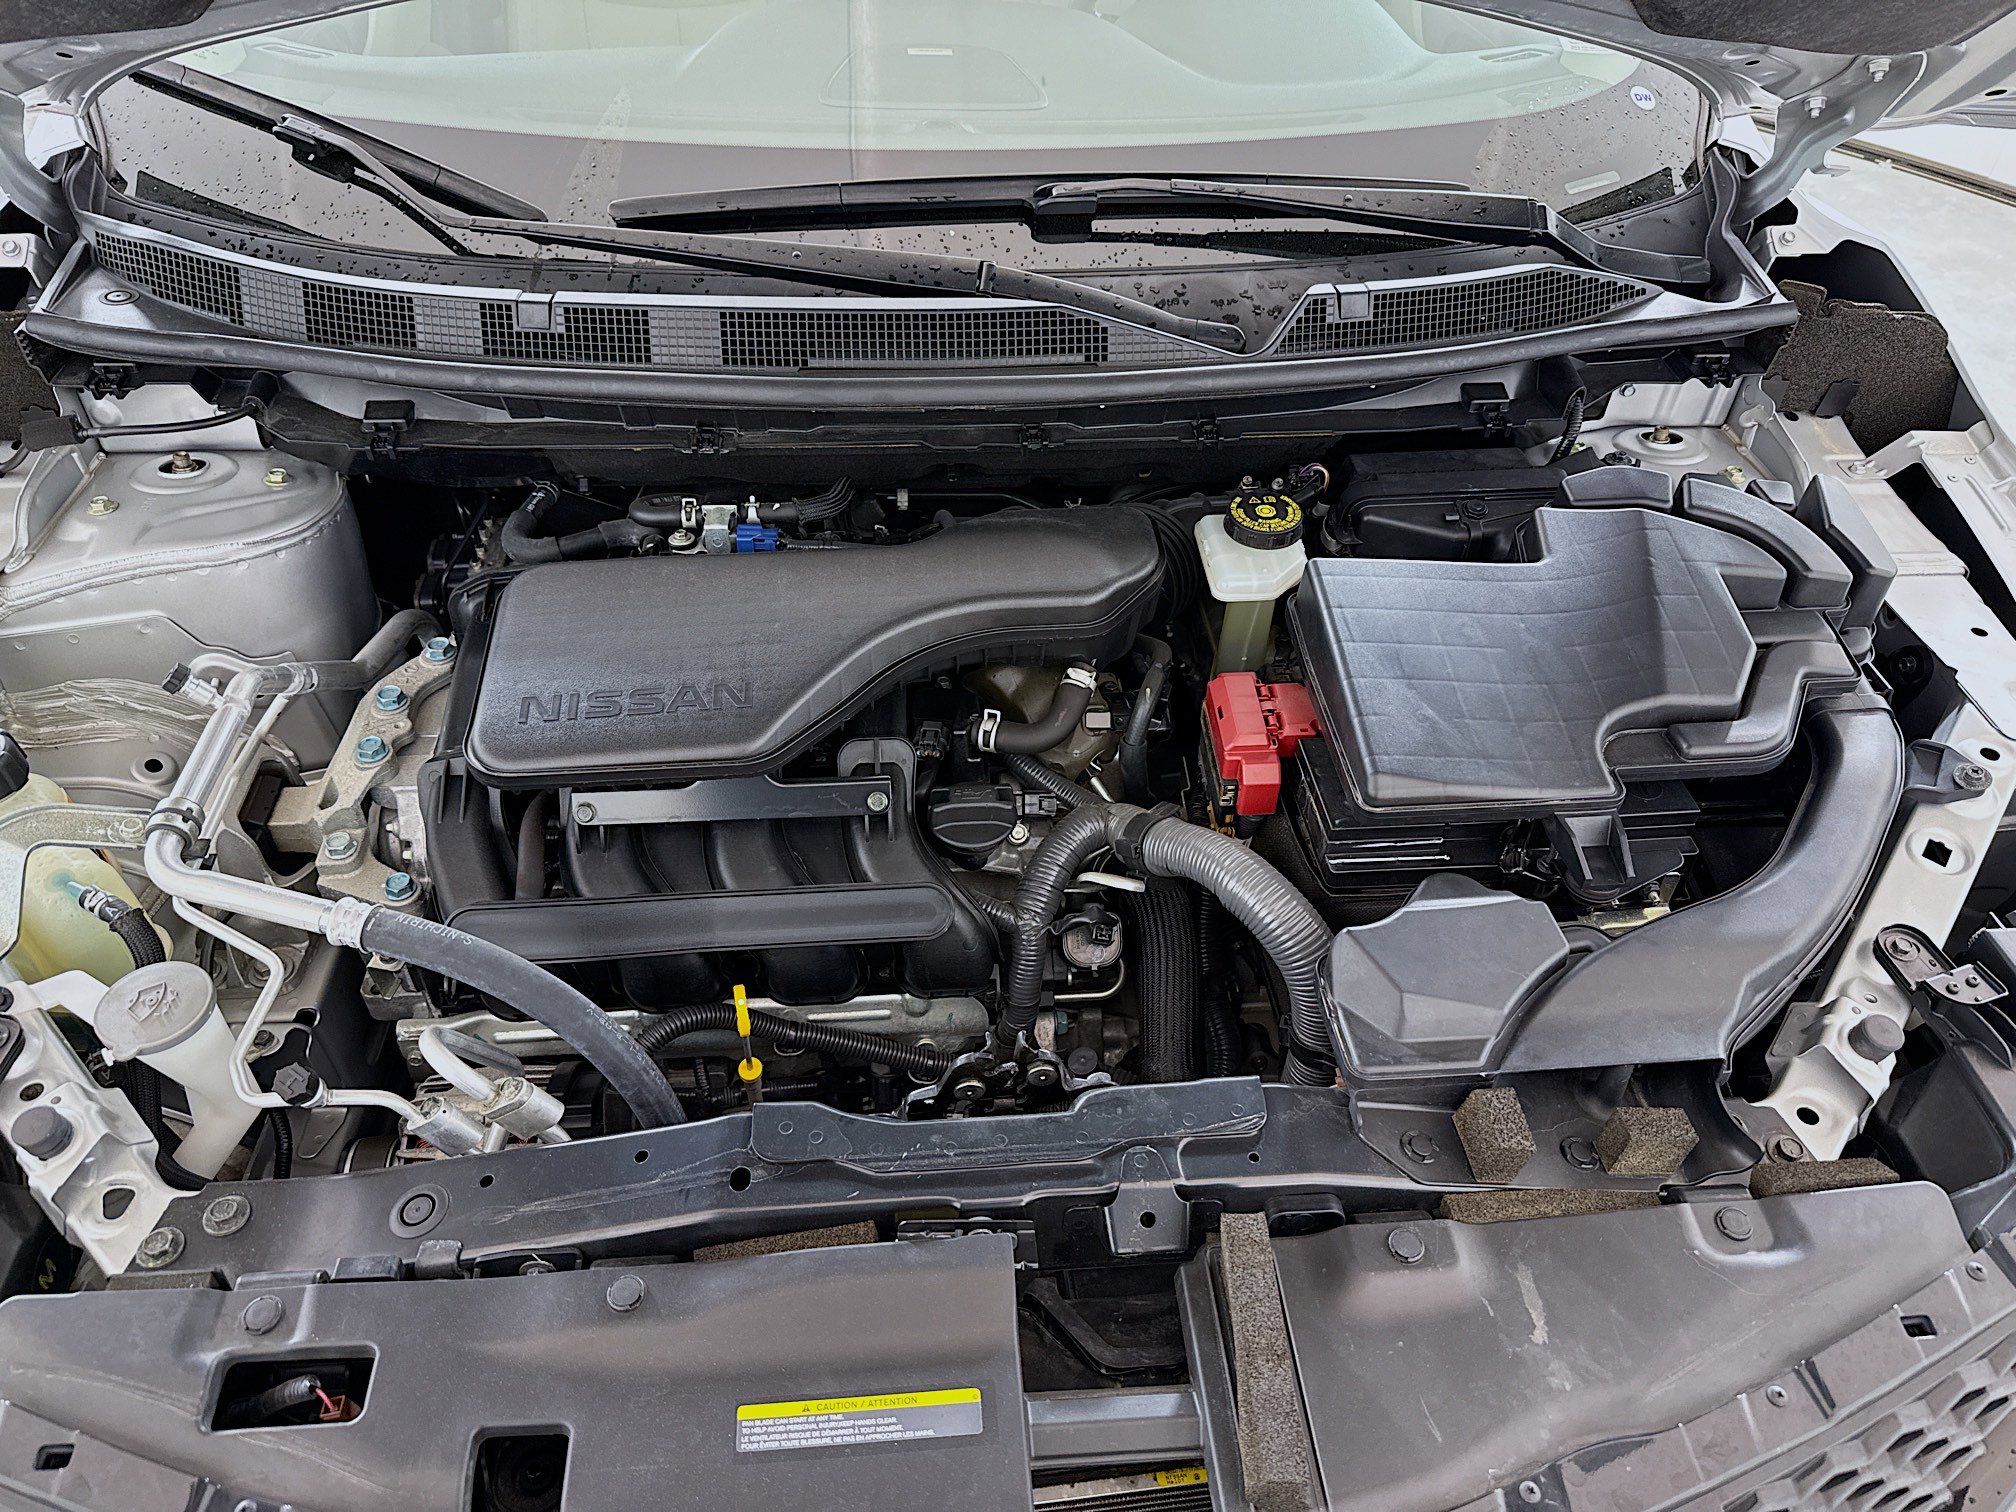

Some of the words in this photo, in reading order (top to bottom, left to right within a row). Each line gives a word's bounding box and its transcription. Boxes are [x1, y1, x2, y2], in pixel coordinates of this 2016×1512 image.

[1634, 93, 1652, 102] DW
[518, 681, 754, 724] NISSAN
[817, 1402, 857, 1411] CAUTION
[868, 1397, 917, 1407] ATTENTION
[742, 1427, 750, 1435] TO
[751, 1426, 767, 1434] HELP
[767, 1424, 786, 1433] AVOID
[787, 1422, 818, 1431] PERSONAL
[754, 1418, 775, 1427] BLADE
[789, 1416, 808, 1424] START
[750, 1433, 788, 1442] VENTILATEUR
[788, 1431, 811, 1439] RISQUE
[821, 1427, 854, 1437] DÉMARRER
[860, 1425, 875, 1433] TOUT
[876, 1424, 904, 1432] MOMENT.
[759, 1440, 779, 1449] ÉVITER
[865, 1431, 902, 1441] APPROCHER
[902, 1430, 914, 1438] LES
[914, 1429, 936, 1437] MAINS.
